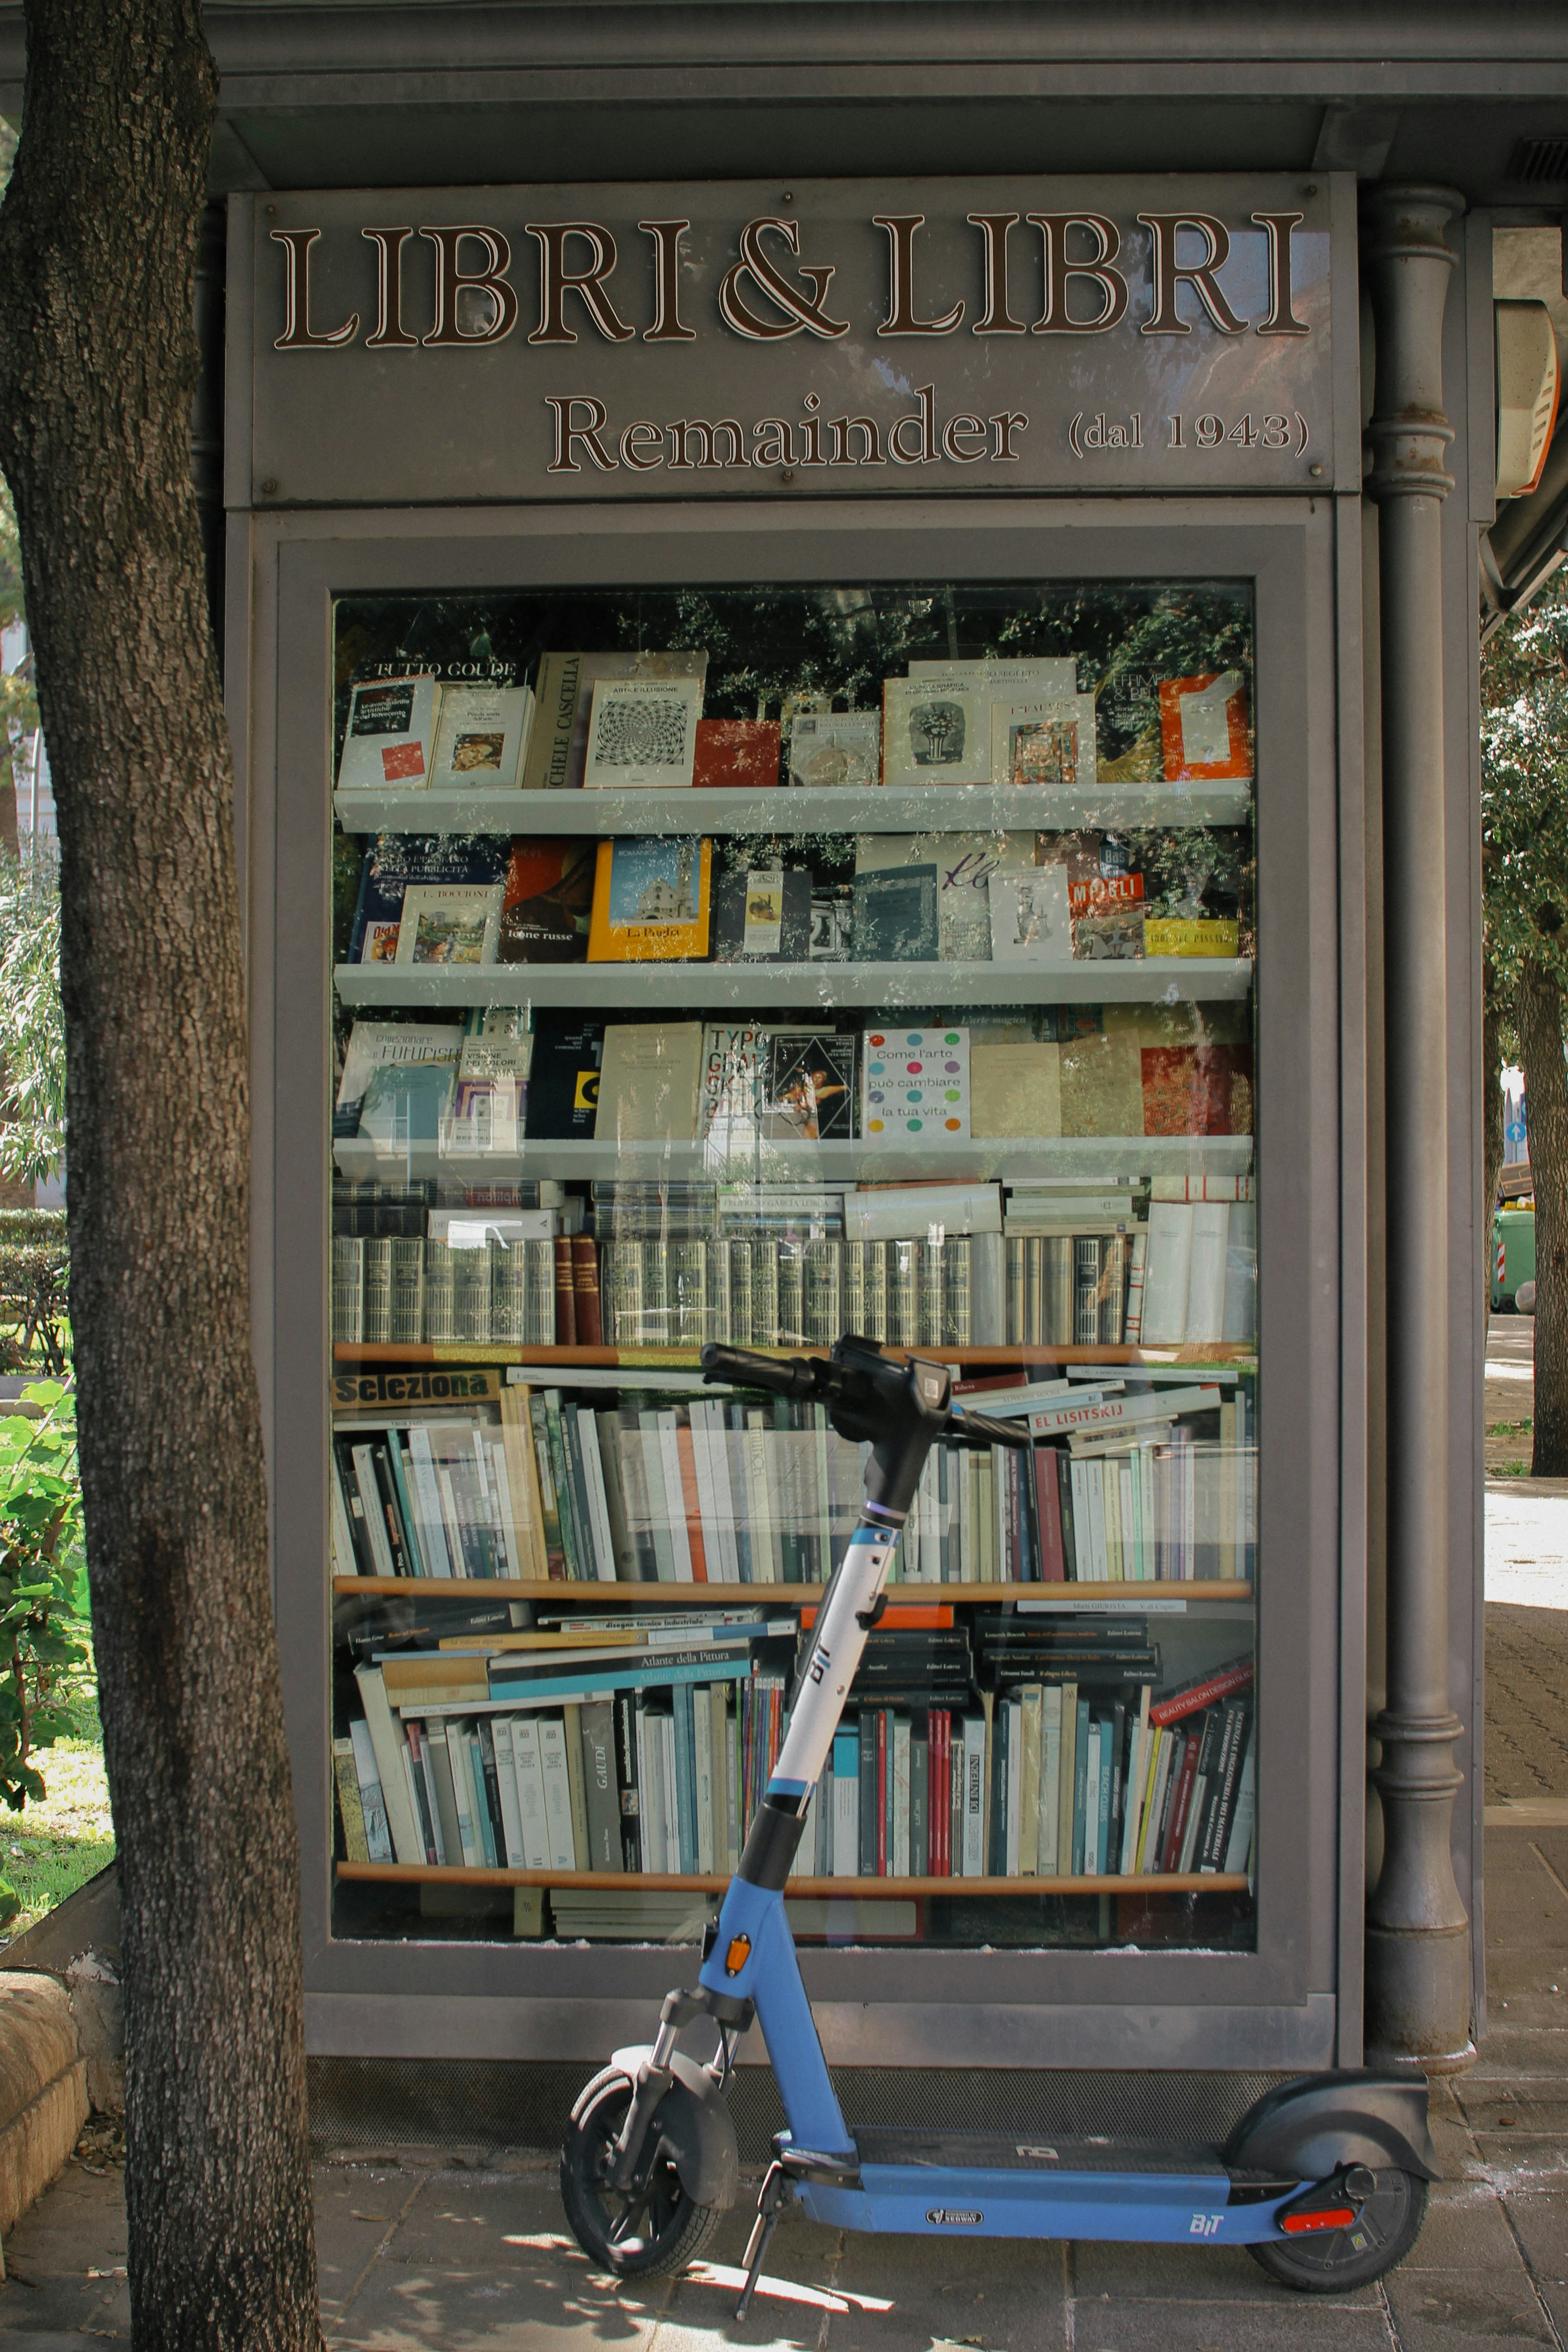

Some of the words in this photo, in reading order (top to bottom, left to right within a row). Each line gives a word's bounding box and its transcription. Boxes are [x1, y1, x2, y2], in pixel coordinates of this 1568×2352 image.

[270, 219, 696, 350] LIBRI
[719, 217, 850, 340] &
[873, 212, 1311, 338] LIBRI
[545, 384, 1029, 474] Remainder
[1067, 412, 1143, 456] (dal
[1166, 411, 1311, 456] 1943)
[557, 657, 579, 730] CASCELLA
[549, 737, 569, 788] CHELE
[438, 890, 488, 899] BOCCIONI
[508, 929, 540, 940] Icone
[543, 931, 573, 941] russe
[877, 1050, 915, 1060] Come
[919, 1049, 953, 1058] l'arte
[869, 1078, 895, 1089] può
[898, 1077, 960, 1087] cambiare
[882, 1107, 893, 1117] la
[898, 1107, 920, 1117] tua
[922, 1106, 947, 1116] vita
[335, 1373, 489, 1404] Seleziona
[1035, 1416, 1051, 1429] EL
[1056, 1404, 1124, 1426] LISITSKIJ
[605, 1619, 634, 1629] disegno
[642, 1656, 674, 1668] Atlante
[677, 1652, 697, 1664] della
[700, 1651, 730, 1661] Pittura
[639, 1672, 672, 1684] Atlante
[674, 1669, 694, 1678] della
[697, 1668, 727, 1678] Pittura
[1158, 1702, 1186, 1720] BEAUTY
[1186, 1690, 1210, 1707] SALON
[1209, 1677, 1236, 1696] DESIGN
[1235, 1670, 1253, 1683] GUID
